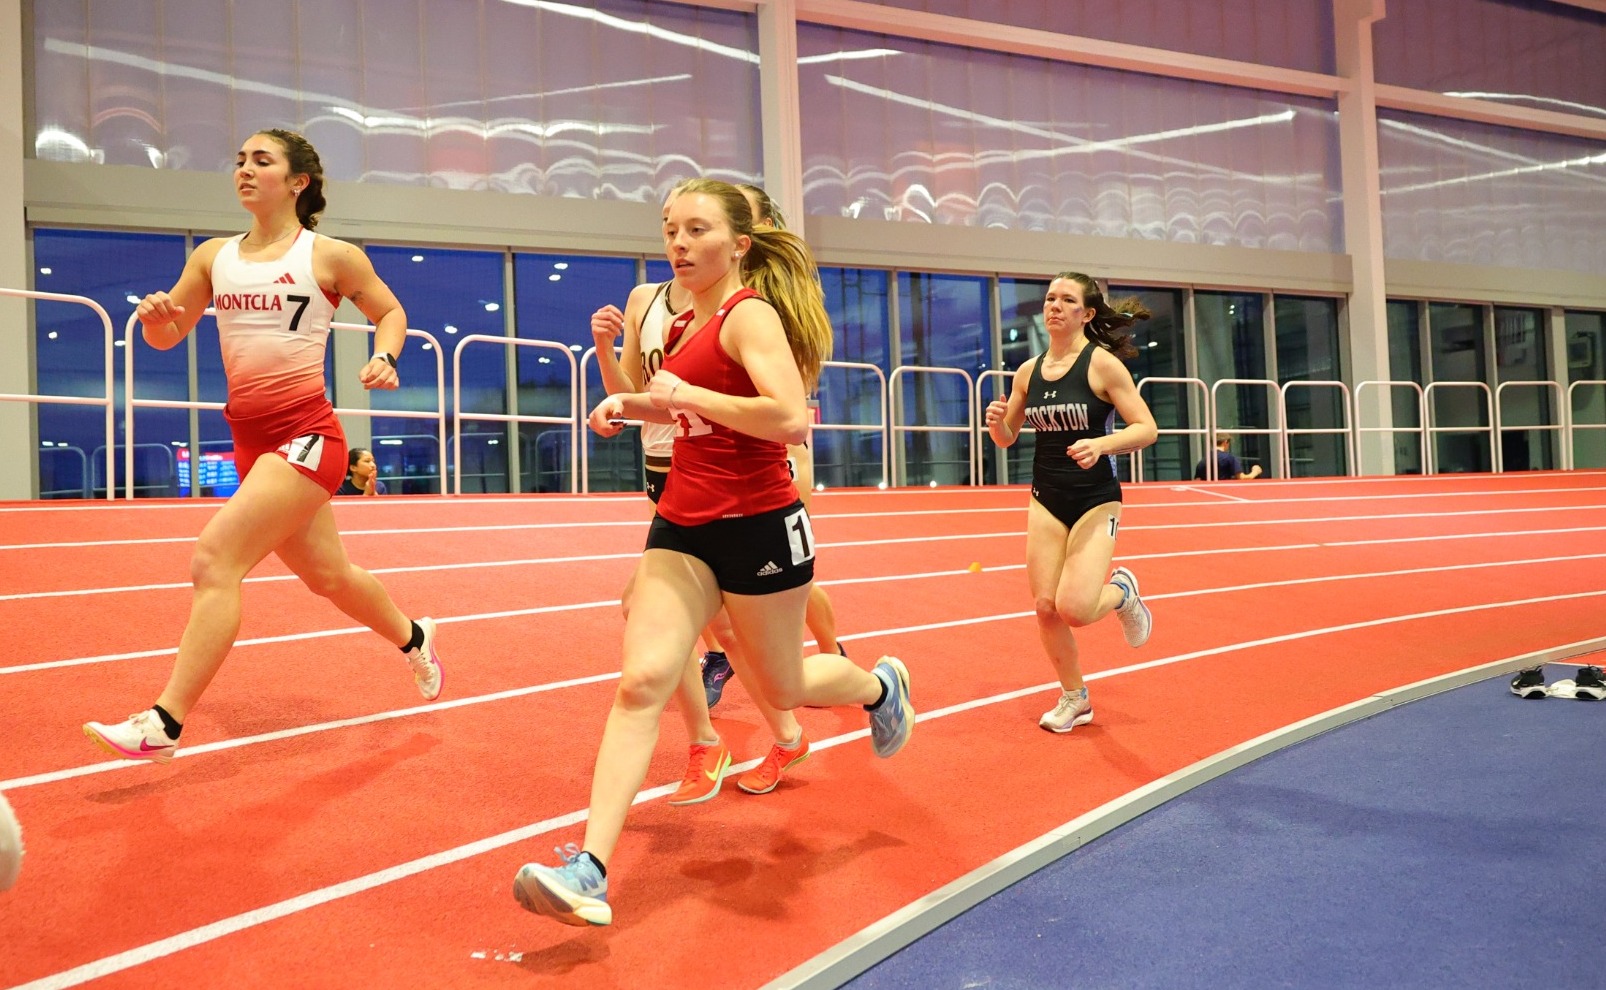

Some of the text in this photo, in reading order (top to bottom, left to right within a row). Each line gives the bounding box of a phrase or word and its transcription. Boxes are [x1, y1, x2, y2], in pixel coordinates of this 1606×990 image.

[287, 295, 310, 331] 7
[792, 515, 810, 558] 1
[1110, 518, 1119, 540] 1
[757, 567, 783, 576] adidas
